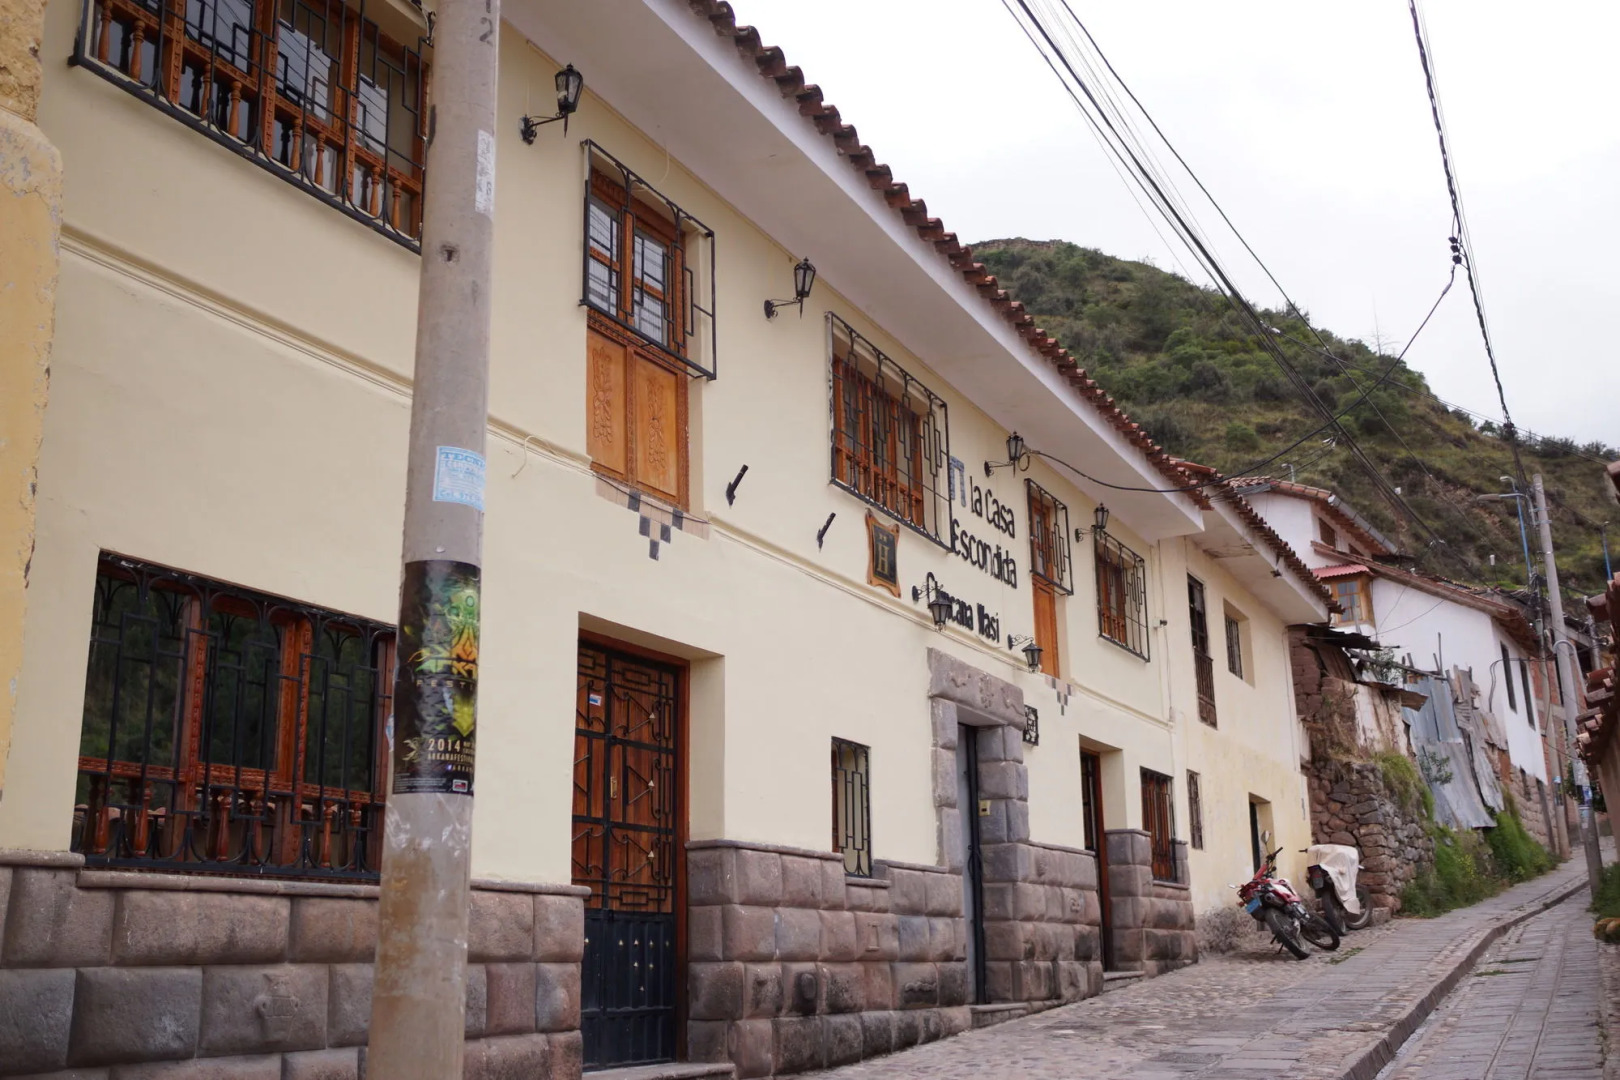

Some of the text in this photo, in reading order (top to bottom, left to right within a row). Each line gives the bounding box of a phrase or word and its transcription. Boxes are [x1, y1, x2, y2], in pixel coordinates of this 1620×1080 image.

[970, 476, 1015, 539] la Casa
[951, 518, 1017, 589] Escondida
[428, 738, 461, 753] 2014
